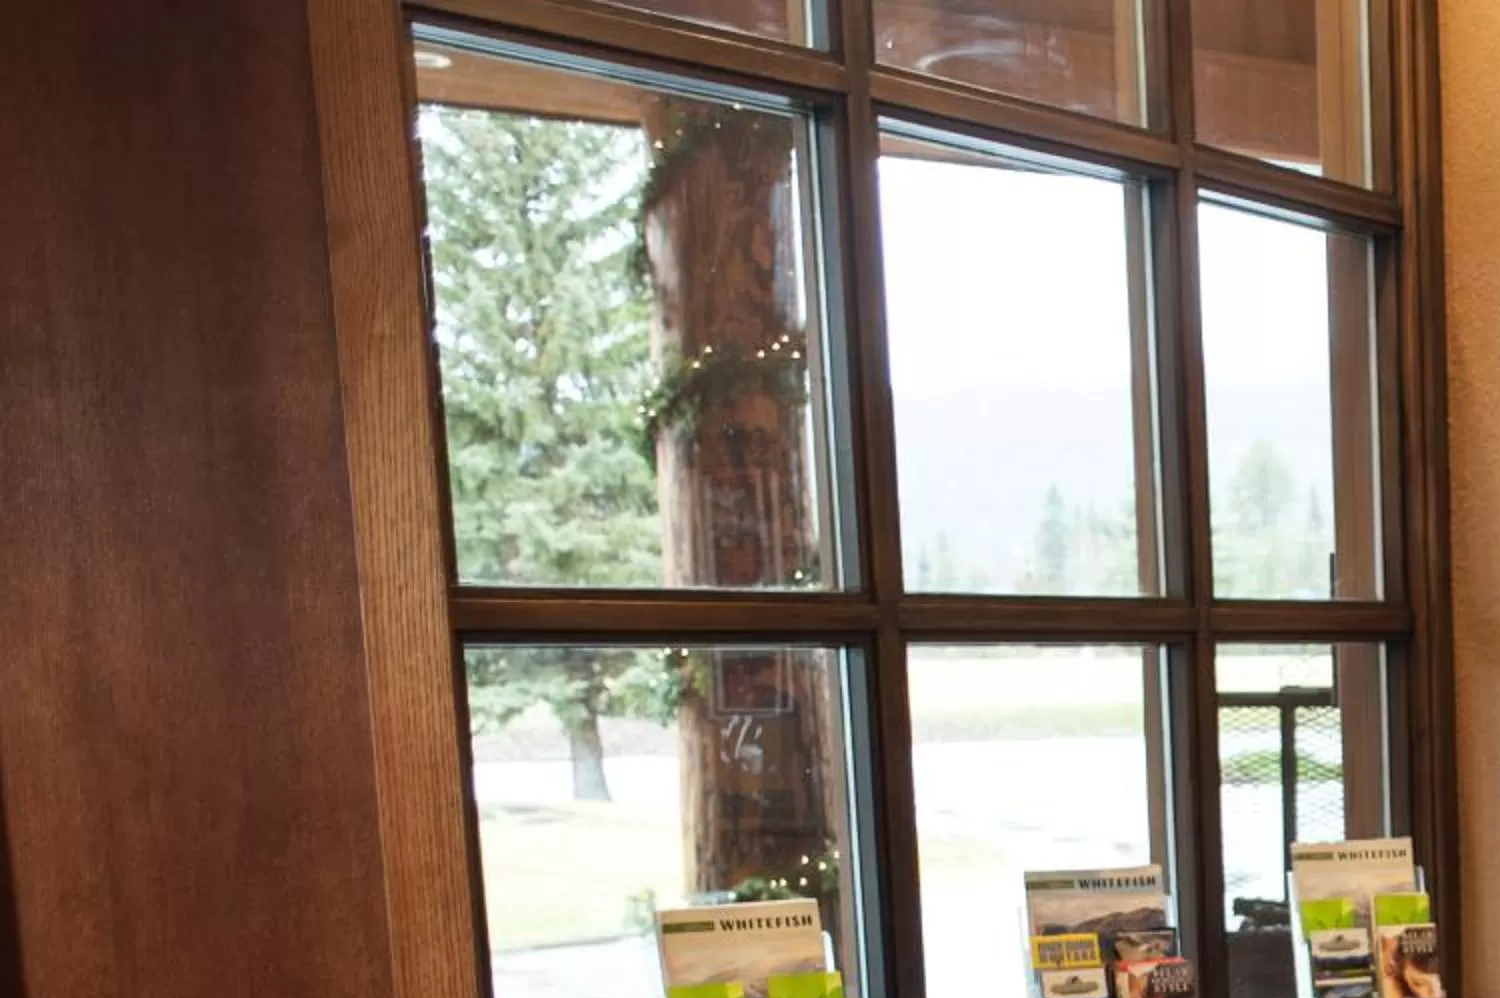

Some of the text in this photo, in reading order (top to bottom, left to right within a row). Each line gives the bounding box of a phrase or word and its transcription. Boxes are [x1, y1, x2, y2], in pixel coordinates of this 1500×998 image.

[1336, 847, 1407, 861] WHITEFISH
[1078, 875, 1157, 889] WHITEFISH
[719, 914, 813, 931] WHITEFISH
